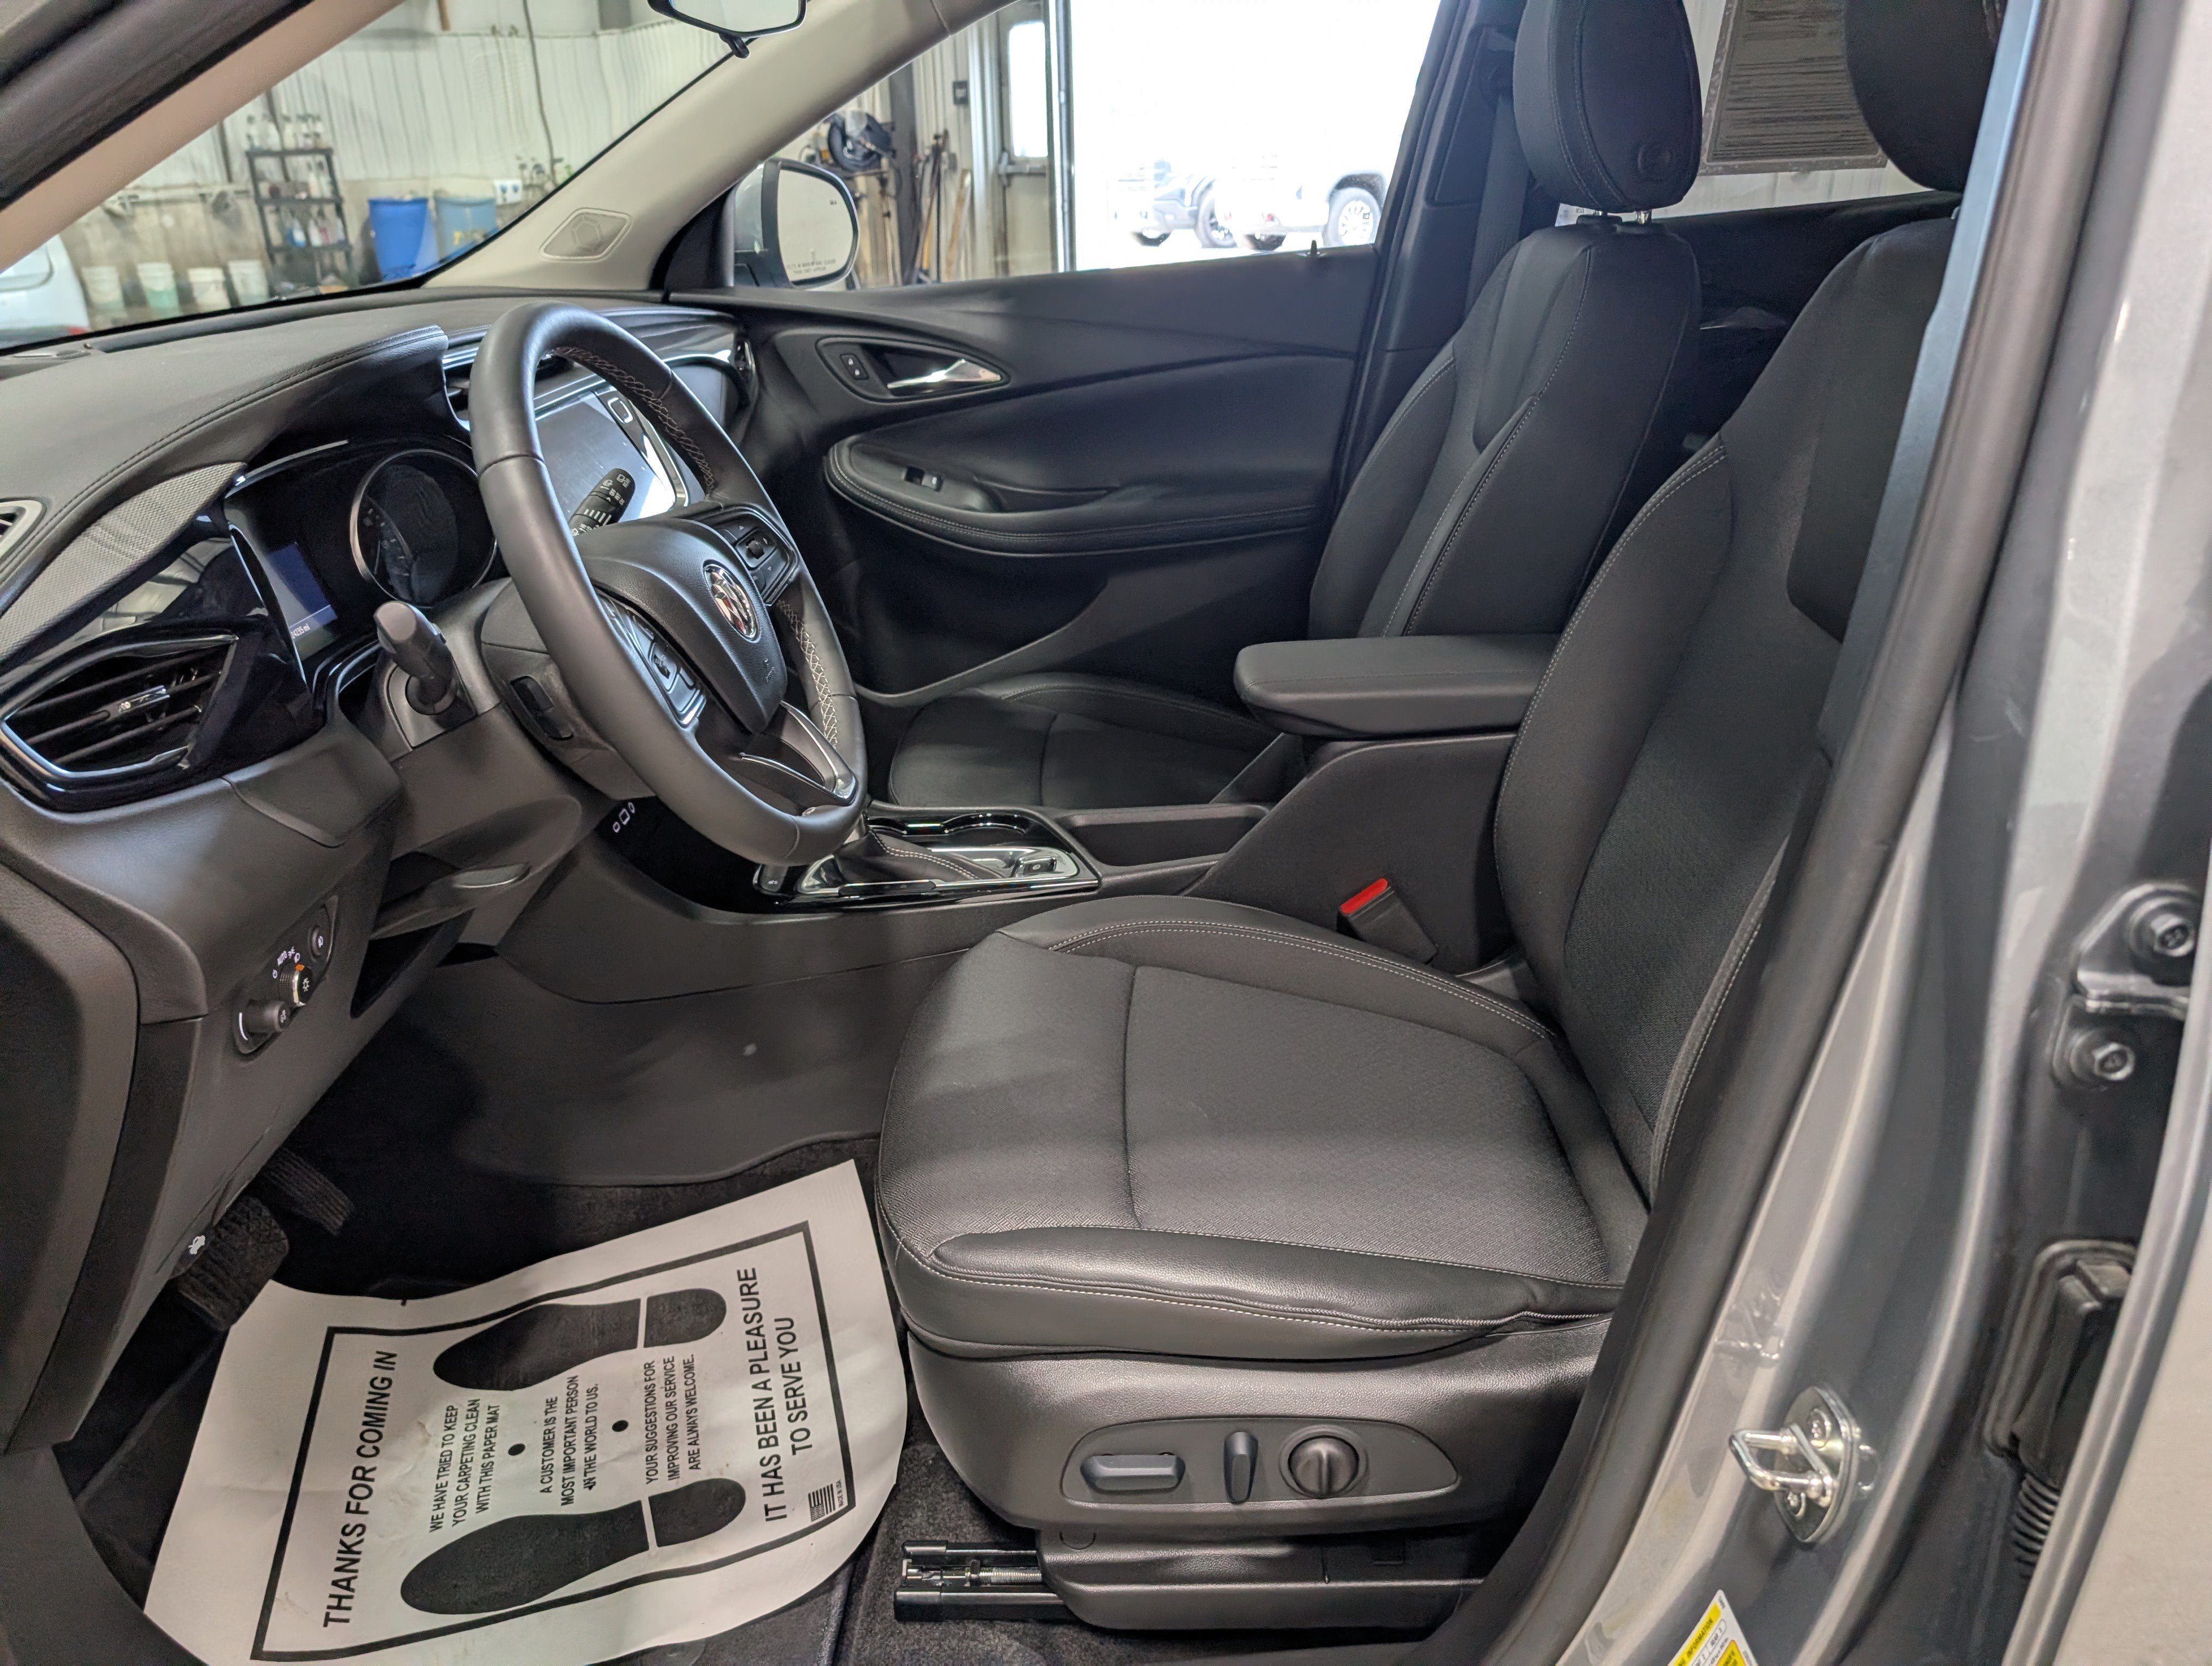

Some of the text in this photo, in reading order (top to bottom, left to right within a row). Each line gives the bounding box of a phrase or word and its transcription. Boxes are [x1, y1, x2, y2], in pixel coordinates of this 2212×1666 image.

[540, 1396, 558, 1494] A CUSTOMER IS THE
[561, 1375, 579, 1506] MOST IMPORTANT PERSON
[583, 1383, 599, 1490] IN THE WORLD TO US.
[644, 1360, 659, 1484] YOUR SUGGESTIONS FOR
[663, 1356, 680, 1481] IMPROVING OUR SERVICE
[683, 1354, 701, 1470] ARE ALWAYS WELCOME.
[737, 1267, 787, 1522] IT HAS BEEN A PLEASURE
[774, 1317, 813, 1456] TO SERVE YOU
[323, 1351, 397, 1627] THANKS FOR COMING IN
[429, 1405, 458, 1533] WE HAVE TRIED TO KEEP
[452, 1398, 480, 1527] YOUR CARPETING CLEAN
[475, 1405, 500, 1514] WITH THIS PAPER MAT
